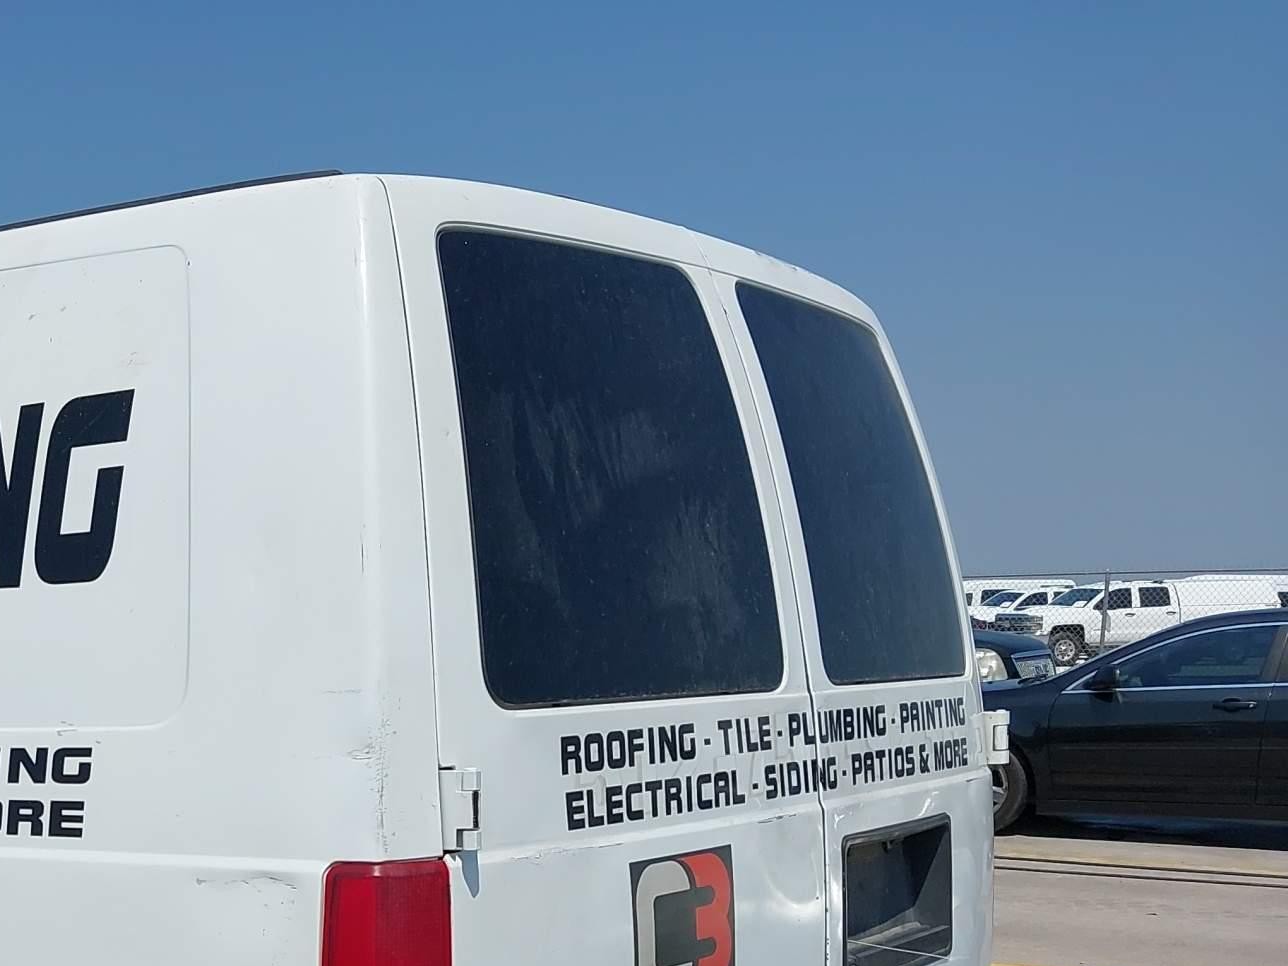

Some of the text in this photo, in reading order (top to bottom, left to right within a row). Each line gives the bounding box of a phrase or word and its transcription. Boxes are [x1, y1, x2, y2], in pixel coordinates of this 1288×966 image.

[560, 722, 698, 776] ROOFING
[717, 715, 772, 756] TILE
[788, 703, 887, 748] PLUMBING
[899, 696, 966, 734] PAINTING
[565, 766, 747, 831] ELECTRICAL
[765, 756, 839, 800] SIDING
[851, 744, 916, 786] PATIOS
[919, 743, 931, 774] &
[933, 737, 968, 772] MORE
